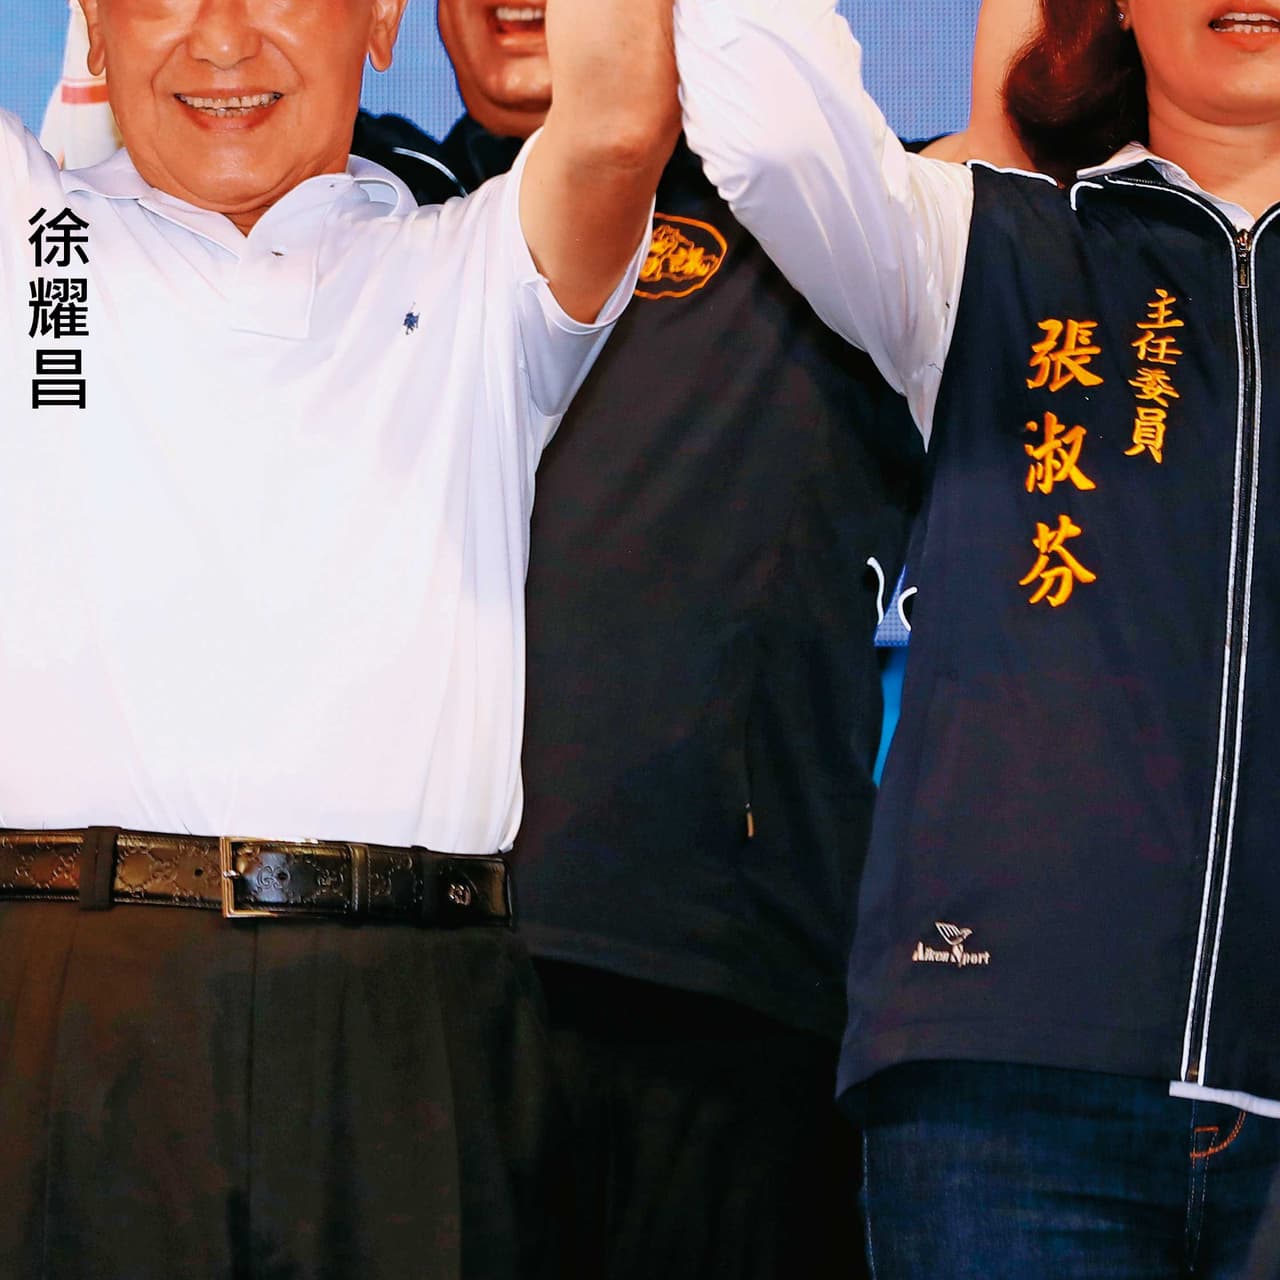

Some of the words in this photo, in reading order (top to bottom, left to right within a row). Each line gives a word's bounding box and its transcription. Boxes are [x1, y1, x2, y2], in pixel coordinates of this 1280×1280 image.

[1018, 318, 1105, 608] 張淑芬
[1123, 288, 1185, 464] 主任委員
